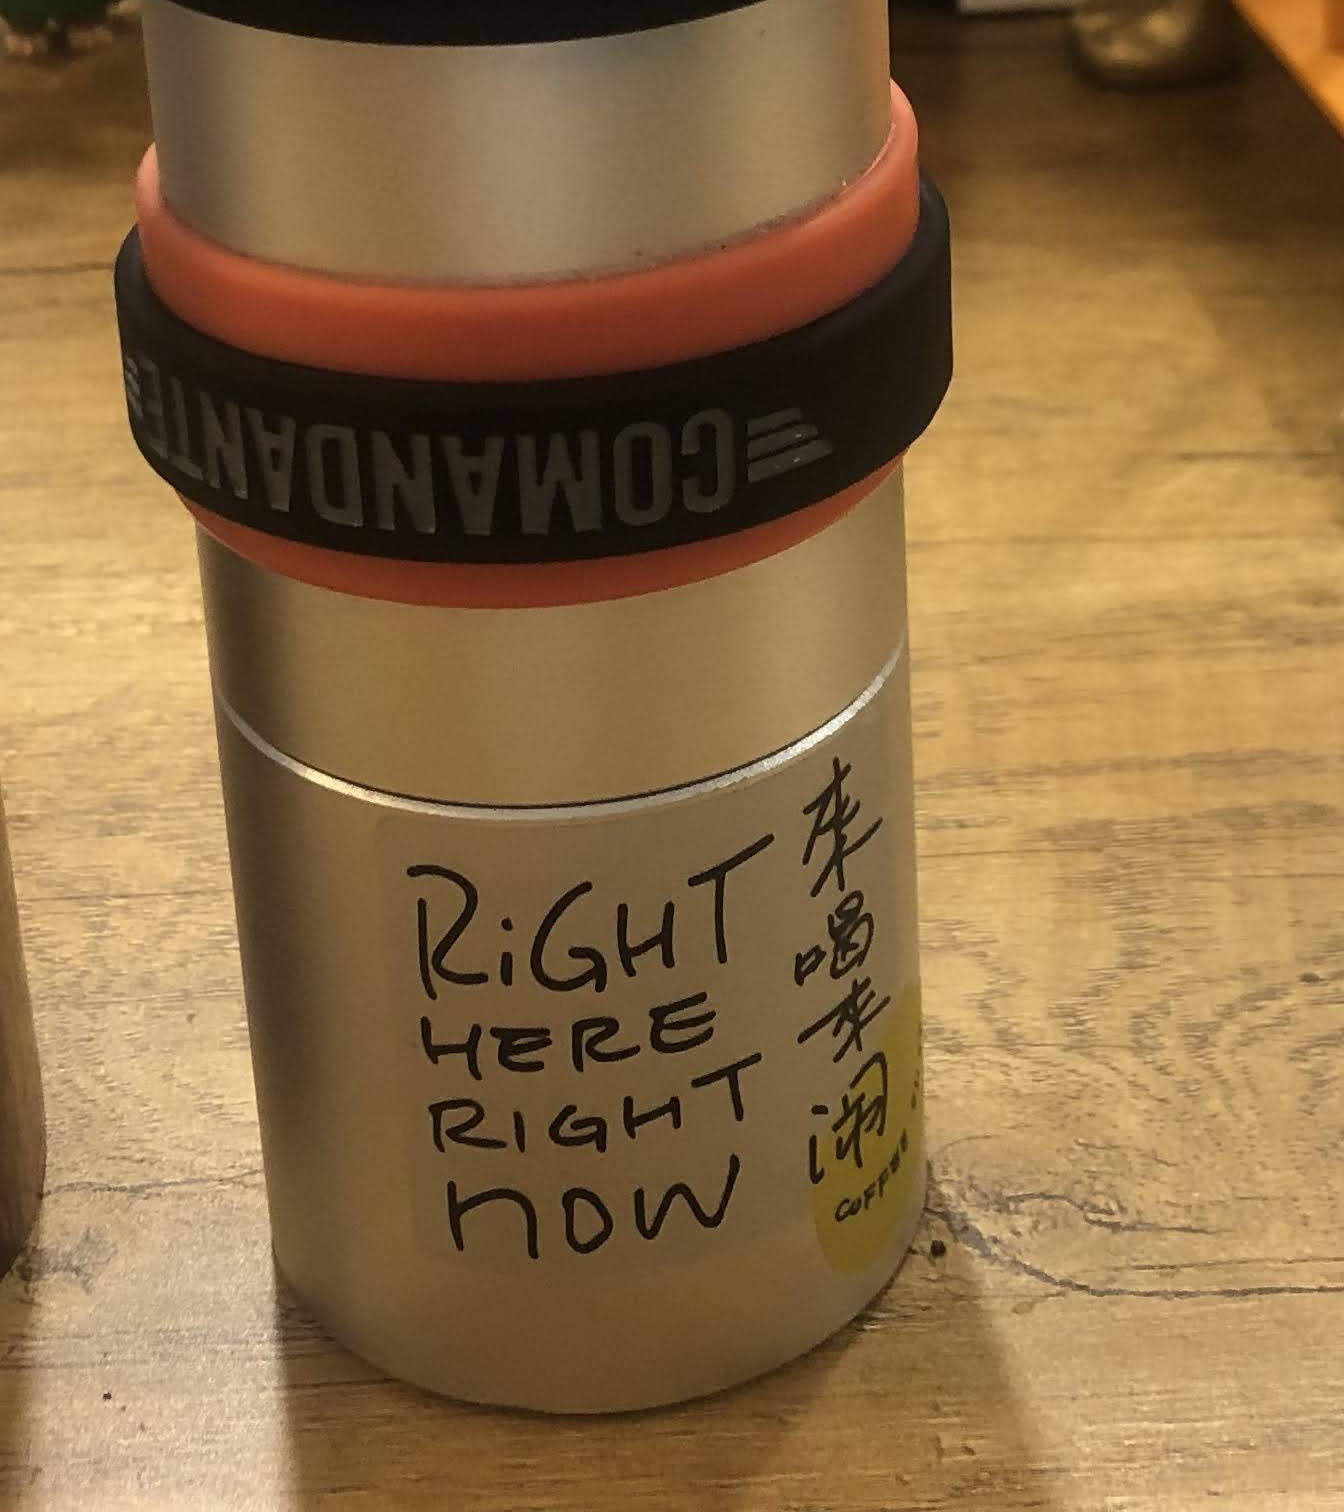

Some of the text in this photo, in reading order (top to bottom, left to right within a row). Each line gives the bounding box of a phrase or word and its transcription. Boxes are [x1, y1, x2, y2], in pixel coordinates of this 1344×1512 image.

[136, 351, 738, 536] COMANDANTE
[420, 991, 717, 1081] HERE
[428, 1052, 762, 1154] RIGHT
